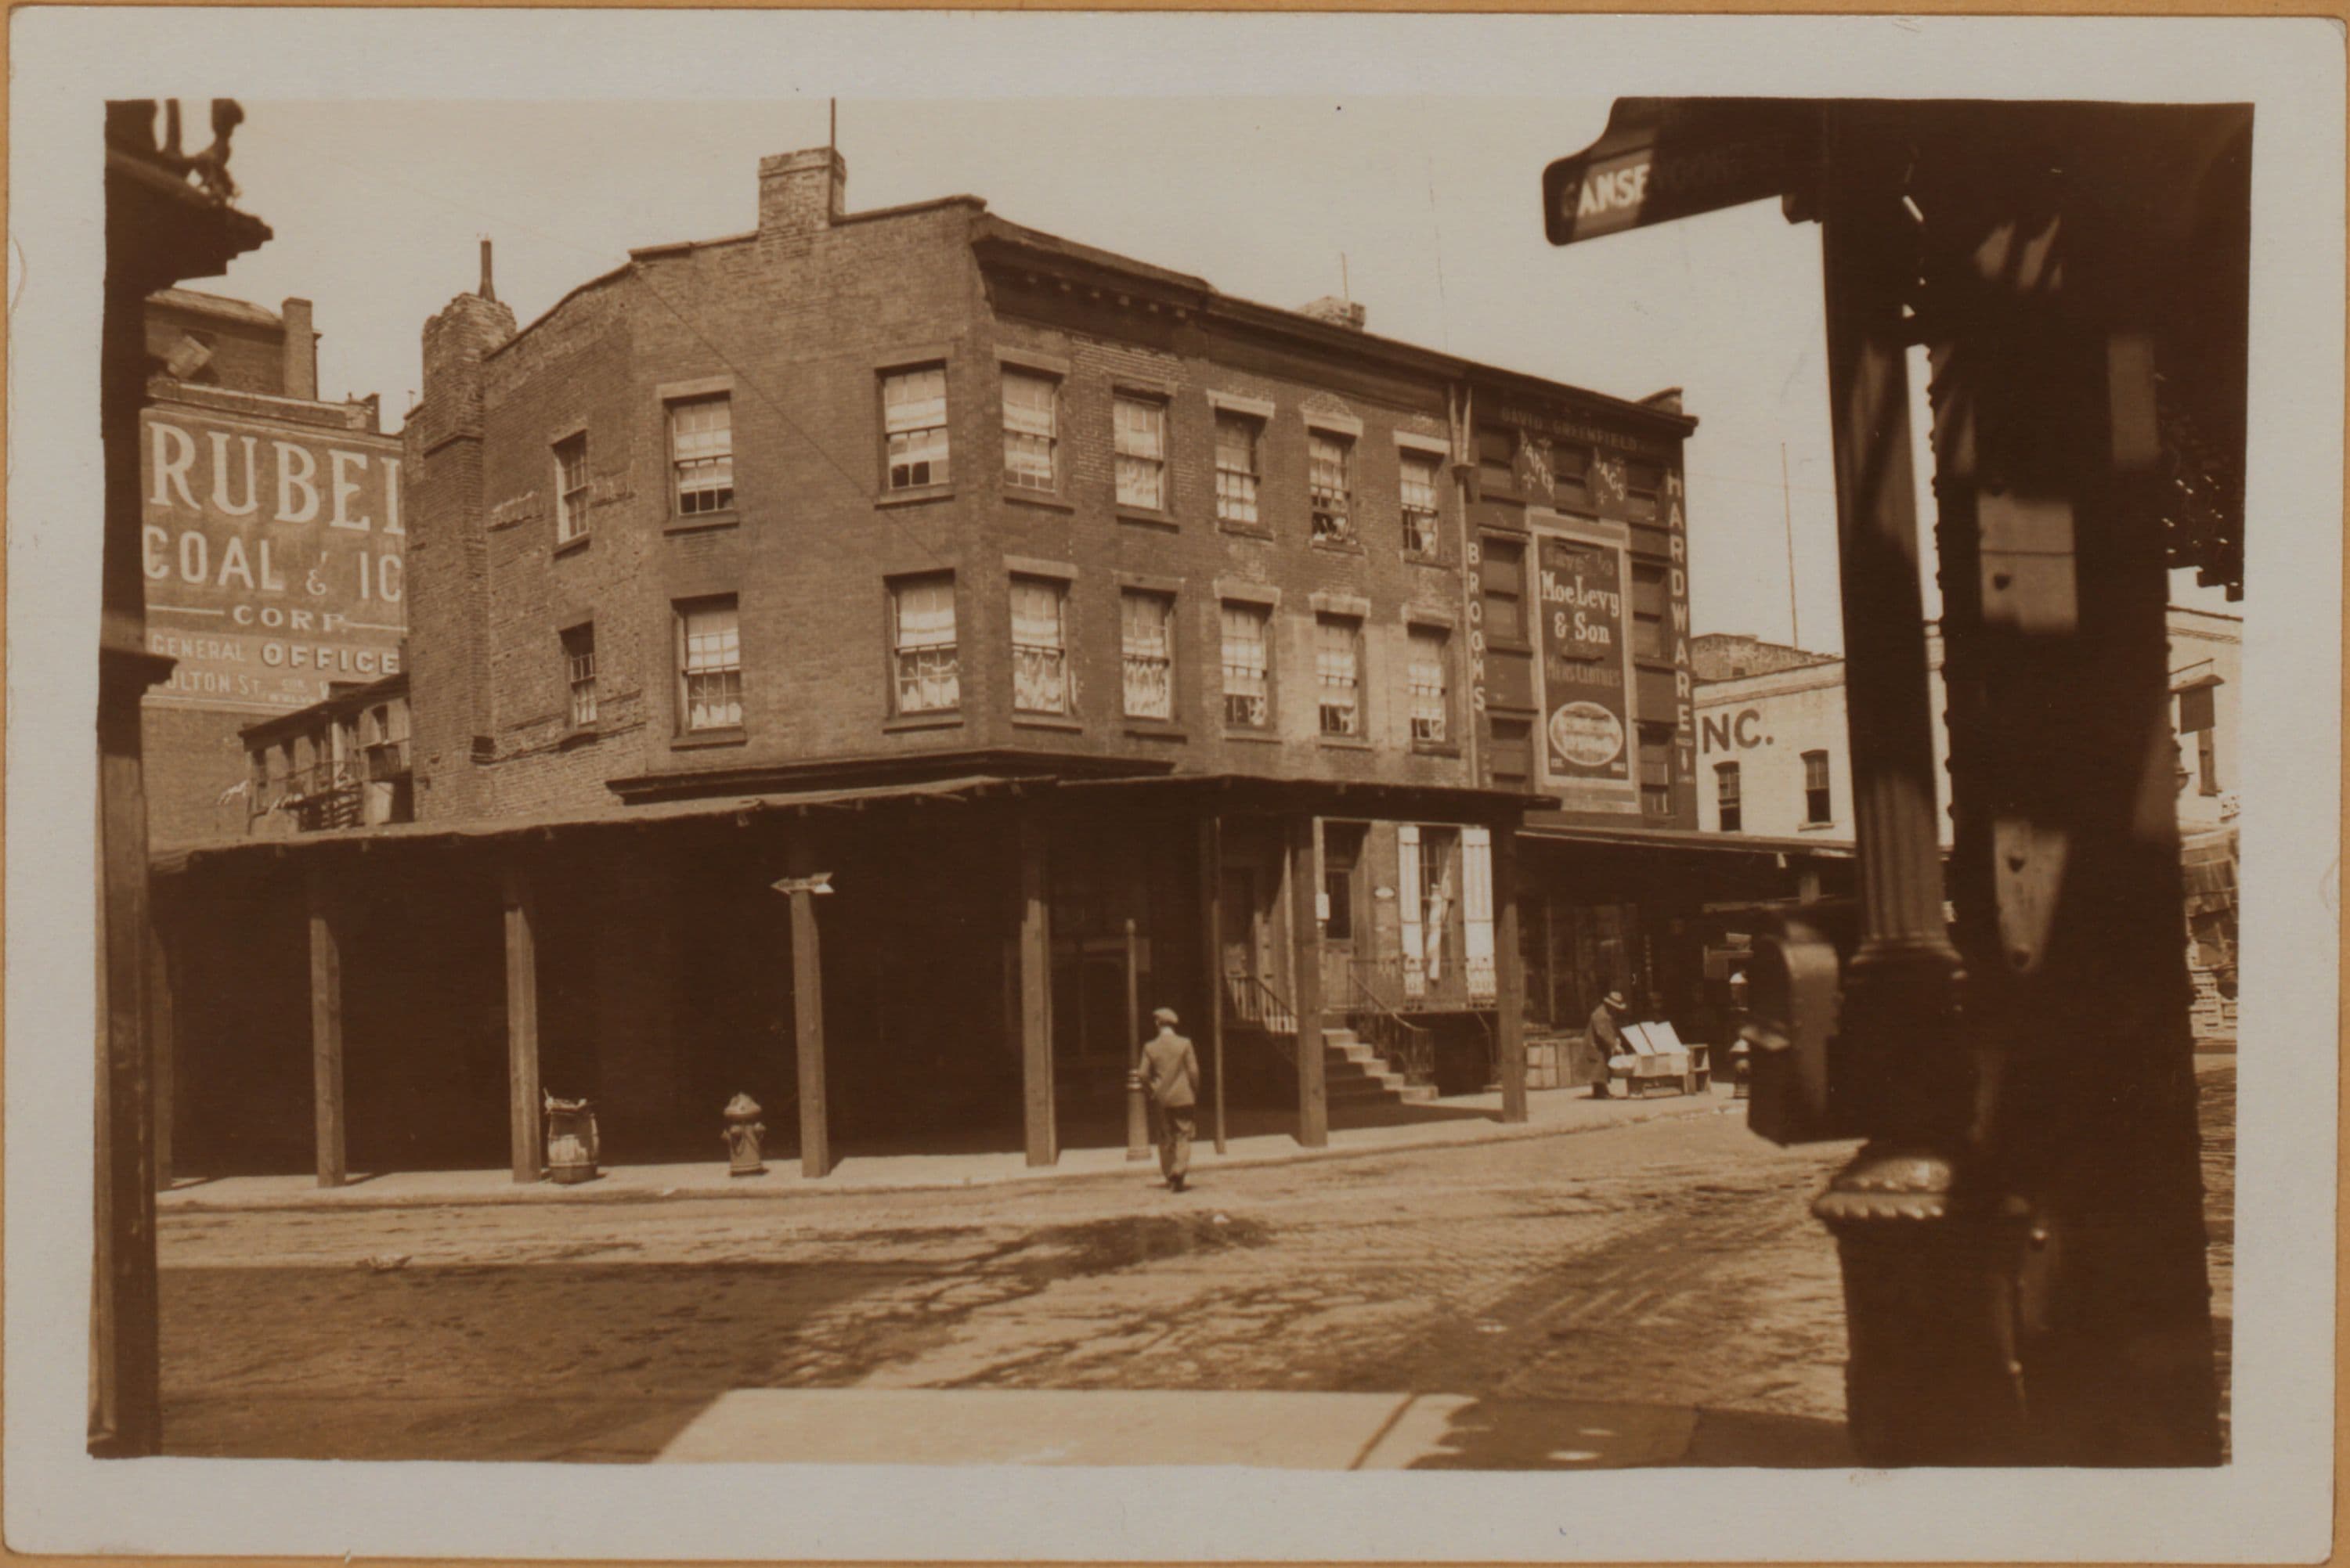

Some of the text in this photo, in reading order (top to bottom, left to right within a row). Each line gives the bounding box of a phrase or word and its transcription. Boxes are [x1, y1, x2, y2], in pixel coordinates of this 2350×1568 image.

[143, 524, 285, 592] COAL
[1540, 570, 1619, 618] Moe Levy
[1666, 468, 1689, 731] HARDWARE
[151, 633, 245, 662] GENERAL
[1467, 541, 1485, 712] BROOMS
[1553, 611, 1612, 644] & Son
